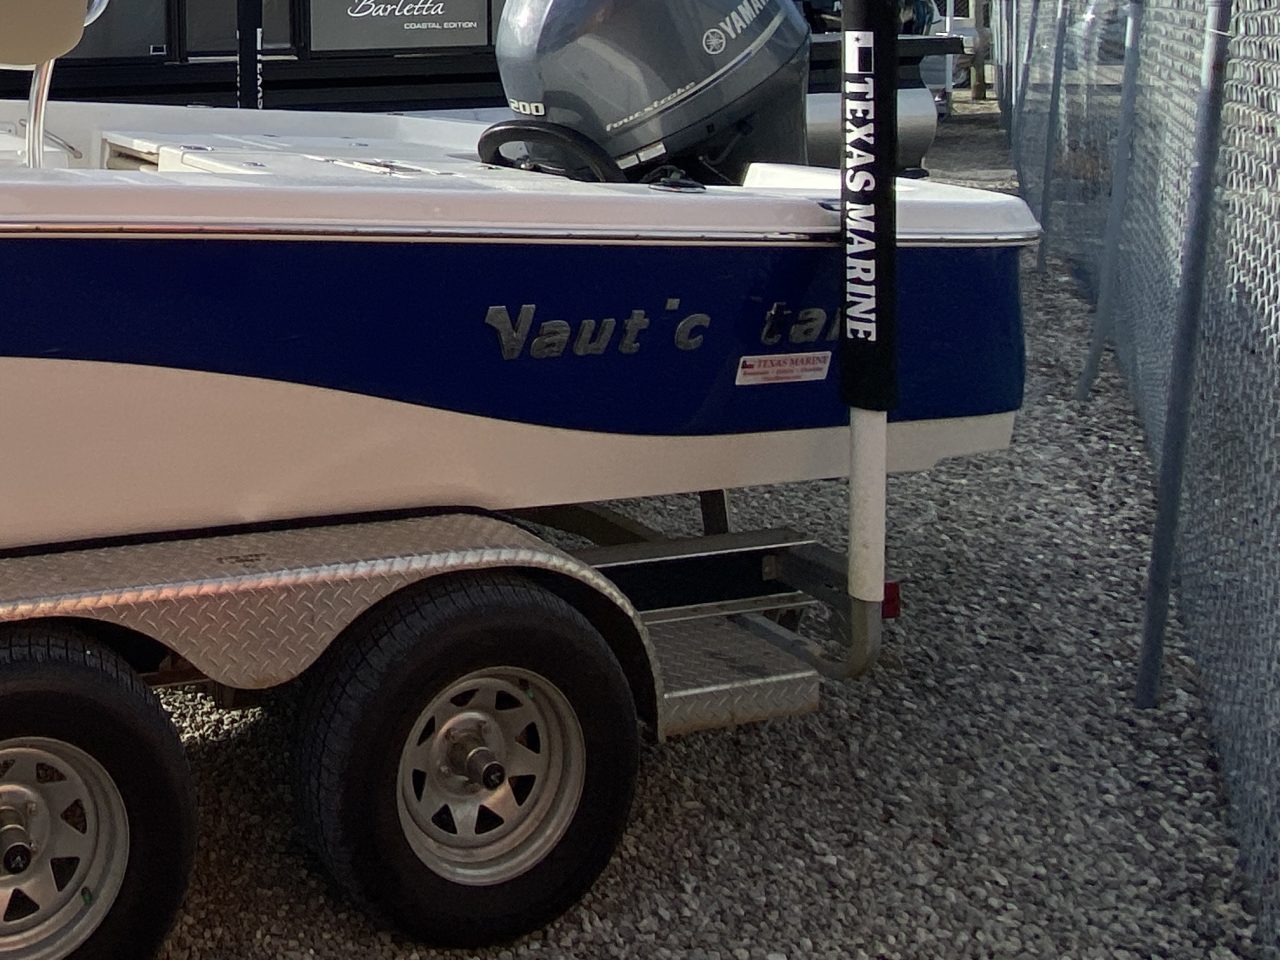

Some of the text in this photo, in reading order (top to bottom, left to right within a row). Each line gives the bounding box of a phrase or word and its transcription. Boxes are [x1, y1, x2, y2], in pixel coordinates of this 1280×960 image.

[403, 21, 477, 30] COASTAL EDITION
[508, 98, 546, 117] 200
[845, 76, 877, 343] TEXAS MARINE
